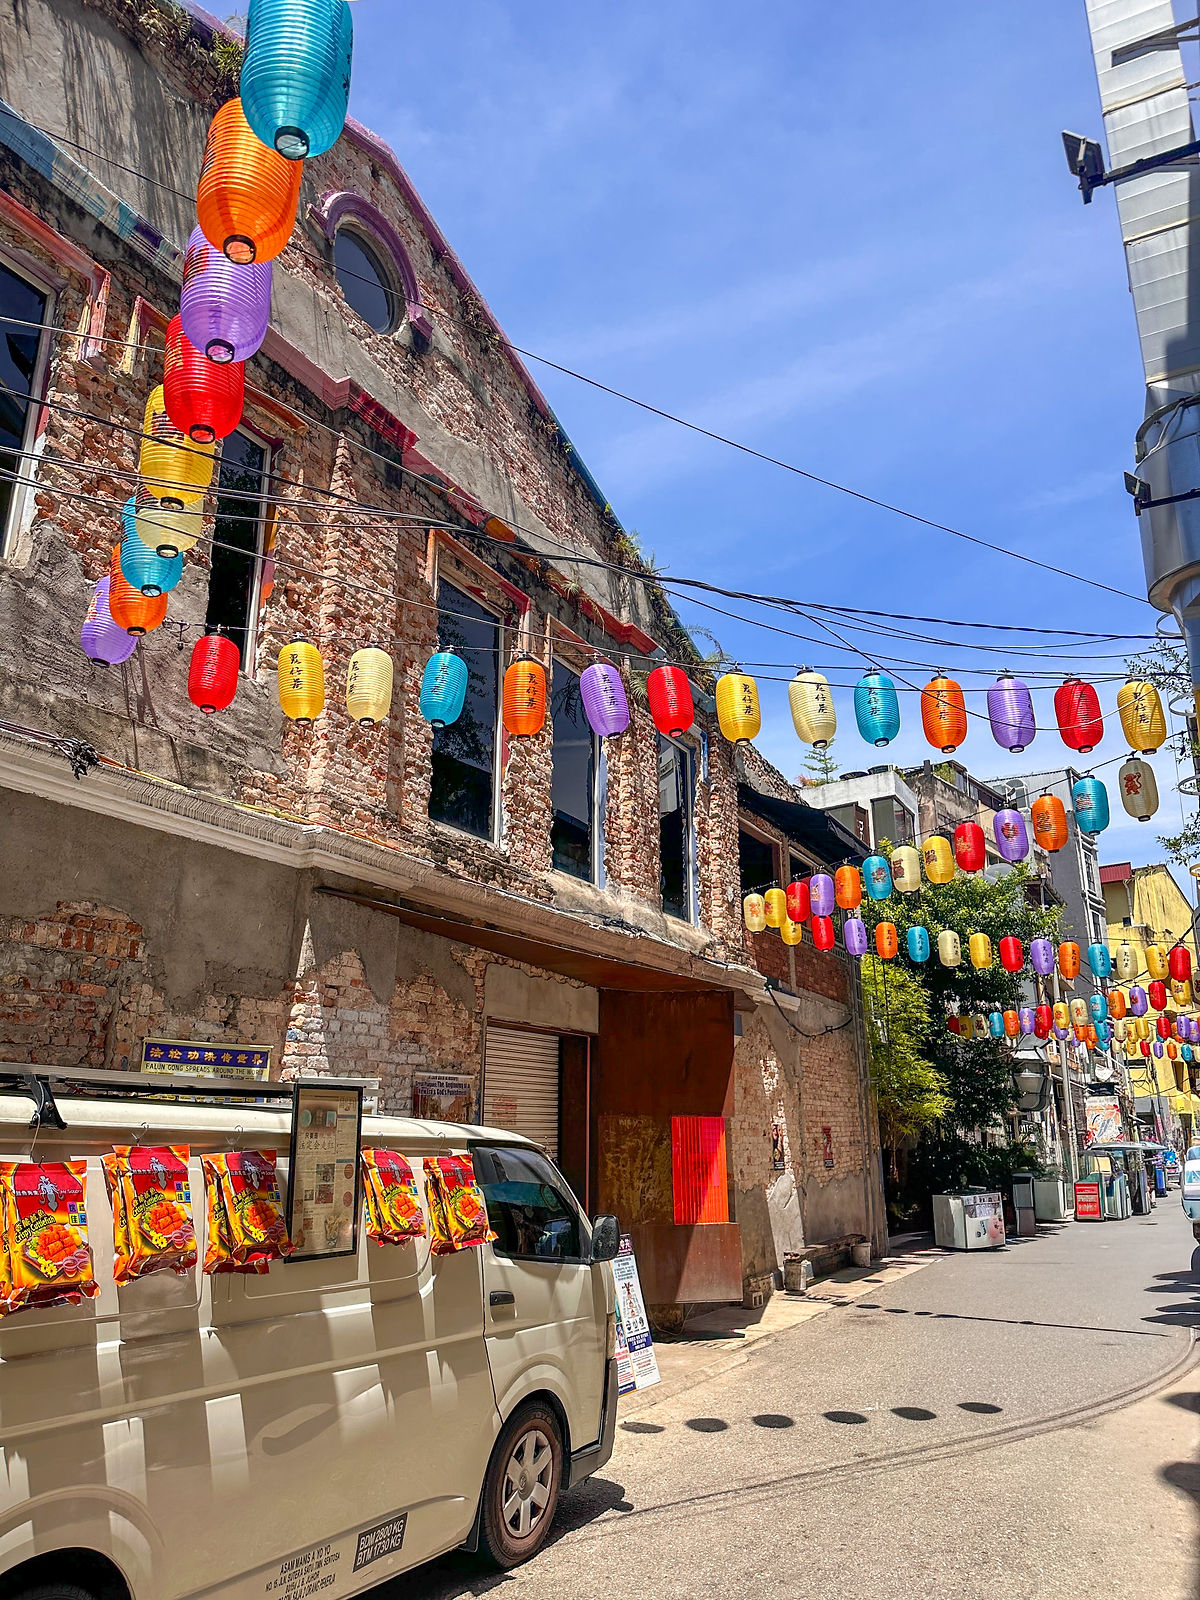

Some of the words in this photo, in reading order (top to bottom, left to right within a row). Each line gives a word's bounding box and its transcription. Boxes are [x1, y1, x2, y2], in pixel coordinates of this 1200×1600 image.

[145, 1063, 165, 1071] FALUN
[167, 1064, 184, 1072] GONG
[185, 1065, 210, 1073] SPREADS
[212, 1067, 237, 1075] AROUND
[236, 1068, 245, 1076] THE
[15, 1228, 32, 1244] Crispy
[31, 1215, 56, 1232] Cuttlefish
[356, 1545, 374, 1566] BTM
[373, 1538, 391, 1557] 1730
[389, 1534, 402, 1549] KG
[359, 1531, 376, 1551] BDM
[374, 1523, 393, 1543] 2800
[392, 1519, 404, 1535] KG
[279, 1559, 296, 1576] ASAM
[324, 1544, 331, 1556] YO
